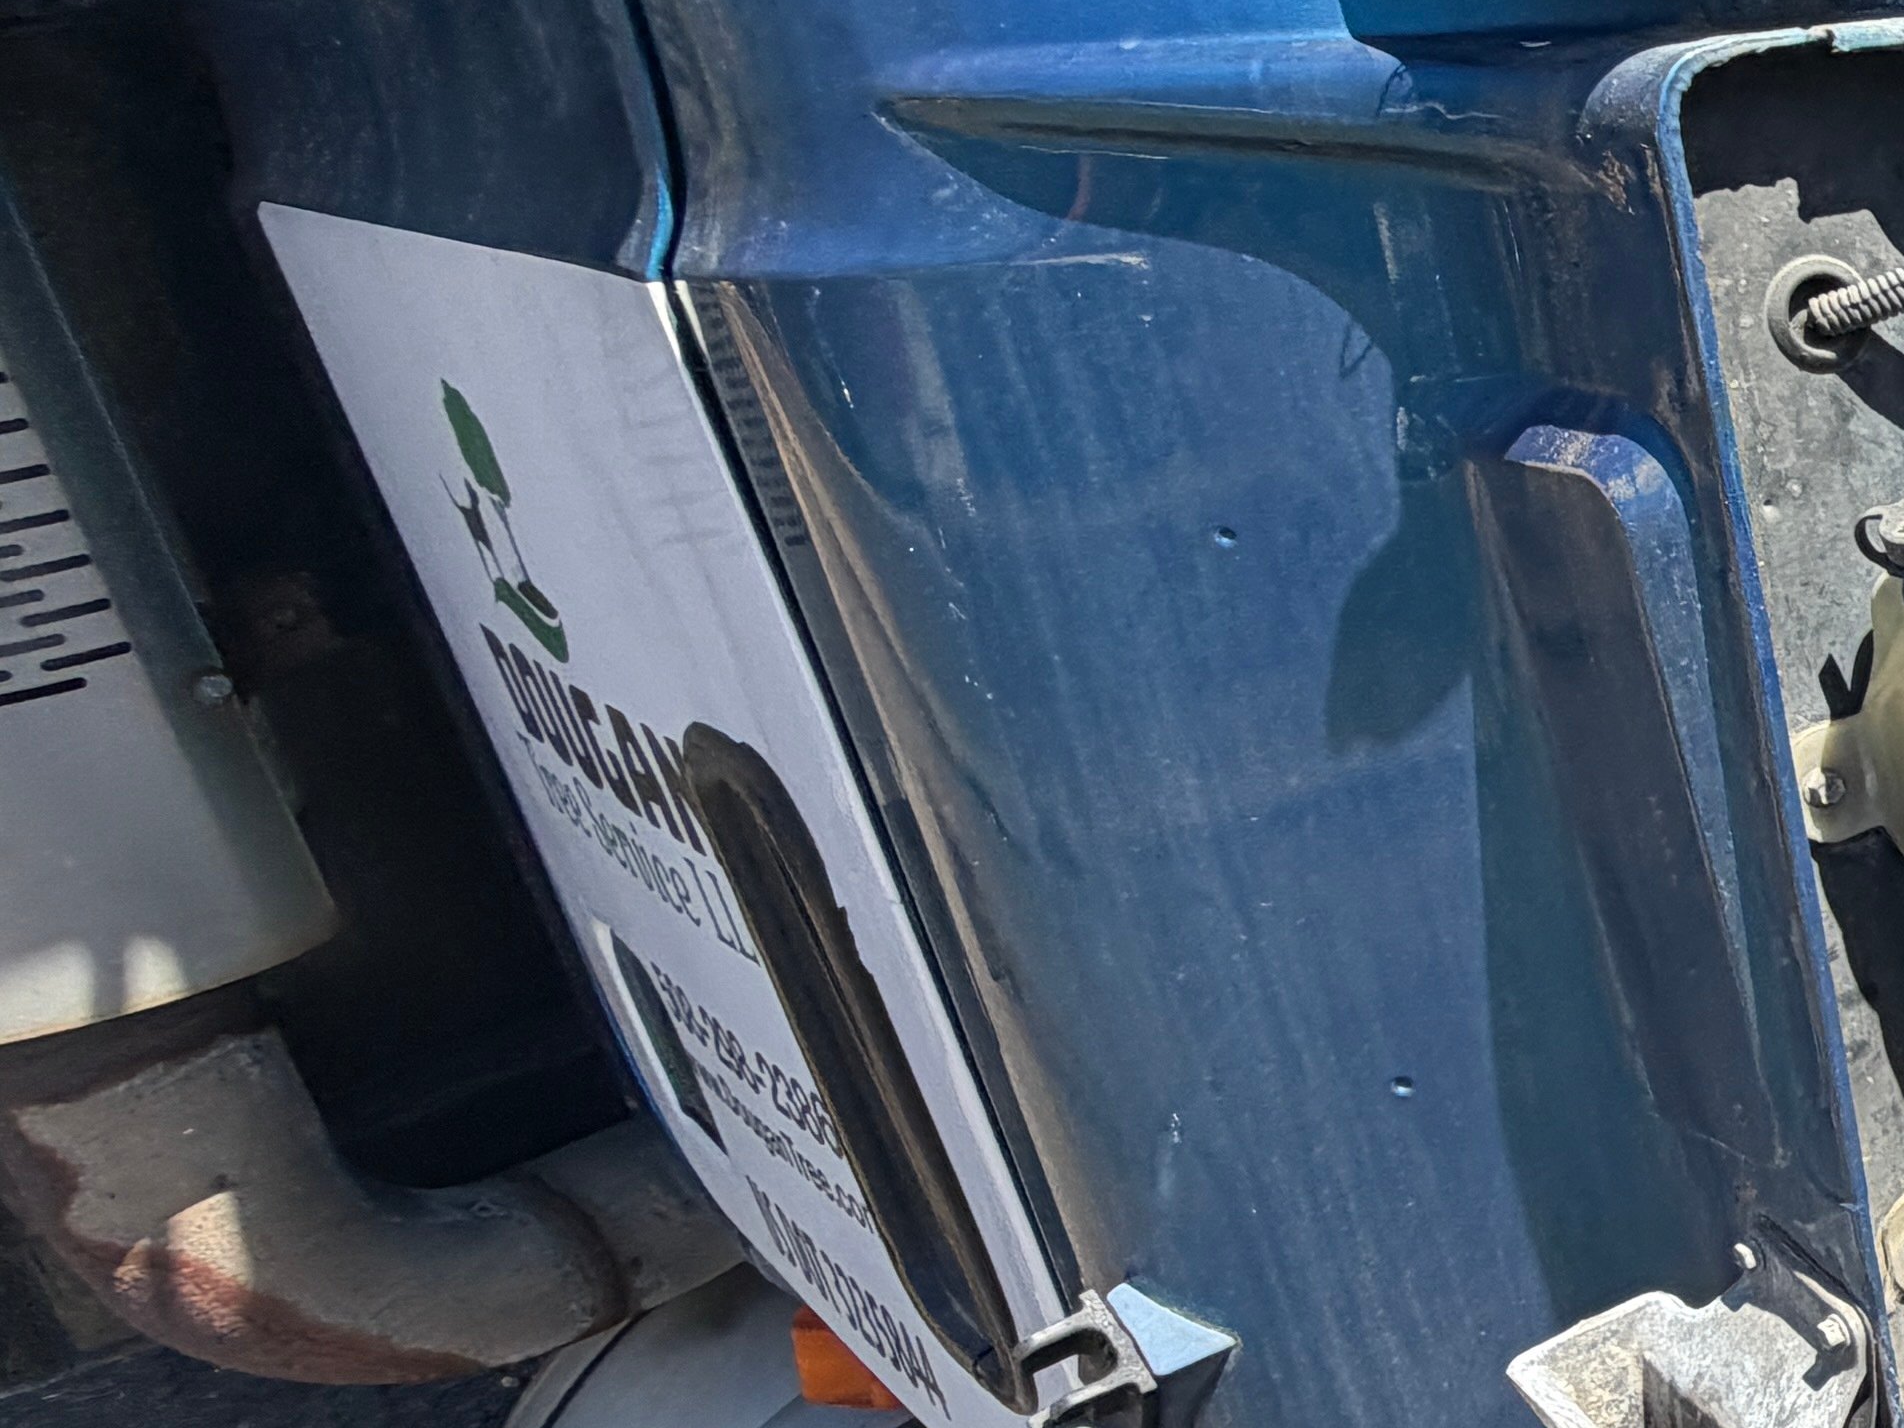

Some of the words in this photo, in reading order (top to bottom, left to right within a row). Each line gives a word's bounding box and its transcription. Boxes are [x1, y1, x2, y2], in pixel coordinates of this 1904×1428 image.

[479, 623, 708, 857] DOUGAN
[516, 730, 593, 839] Tree
[572, 777, 701, 927] Service
[683, 856, 762, 967] LL
[819, 1249, 952, 1421] 3235844
